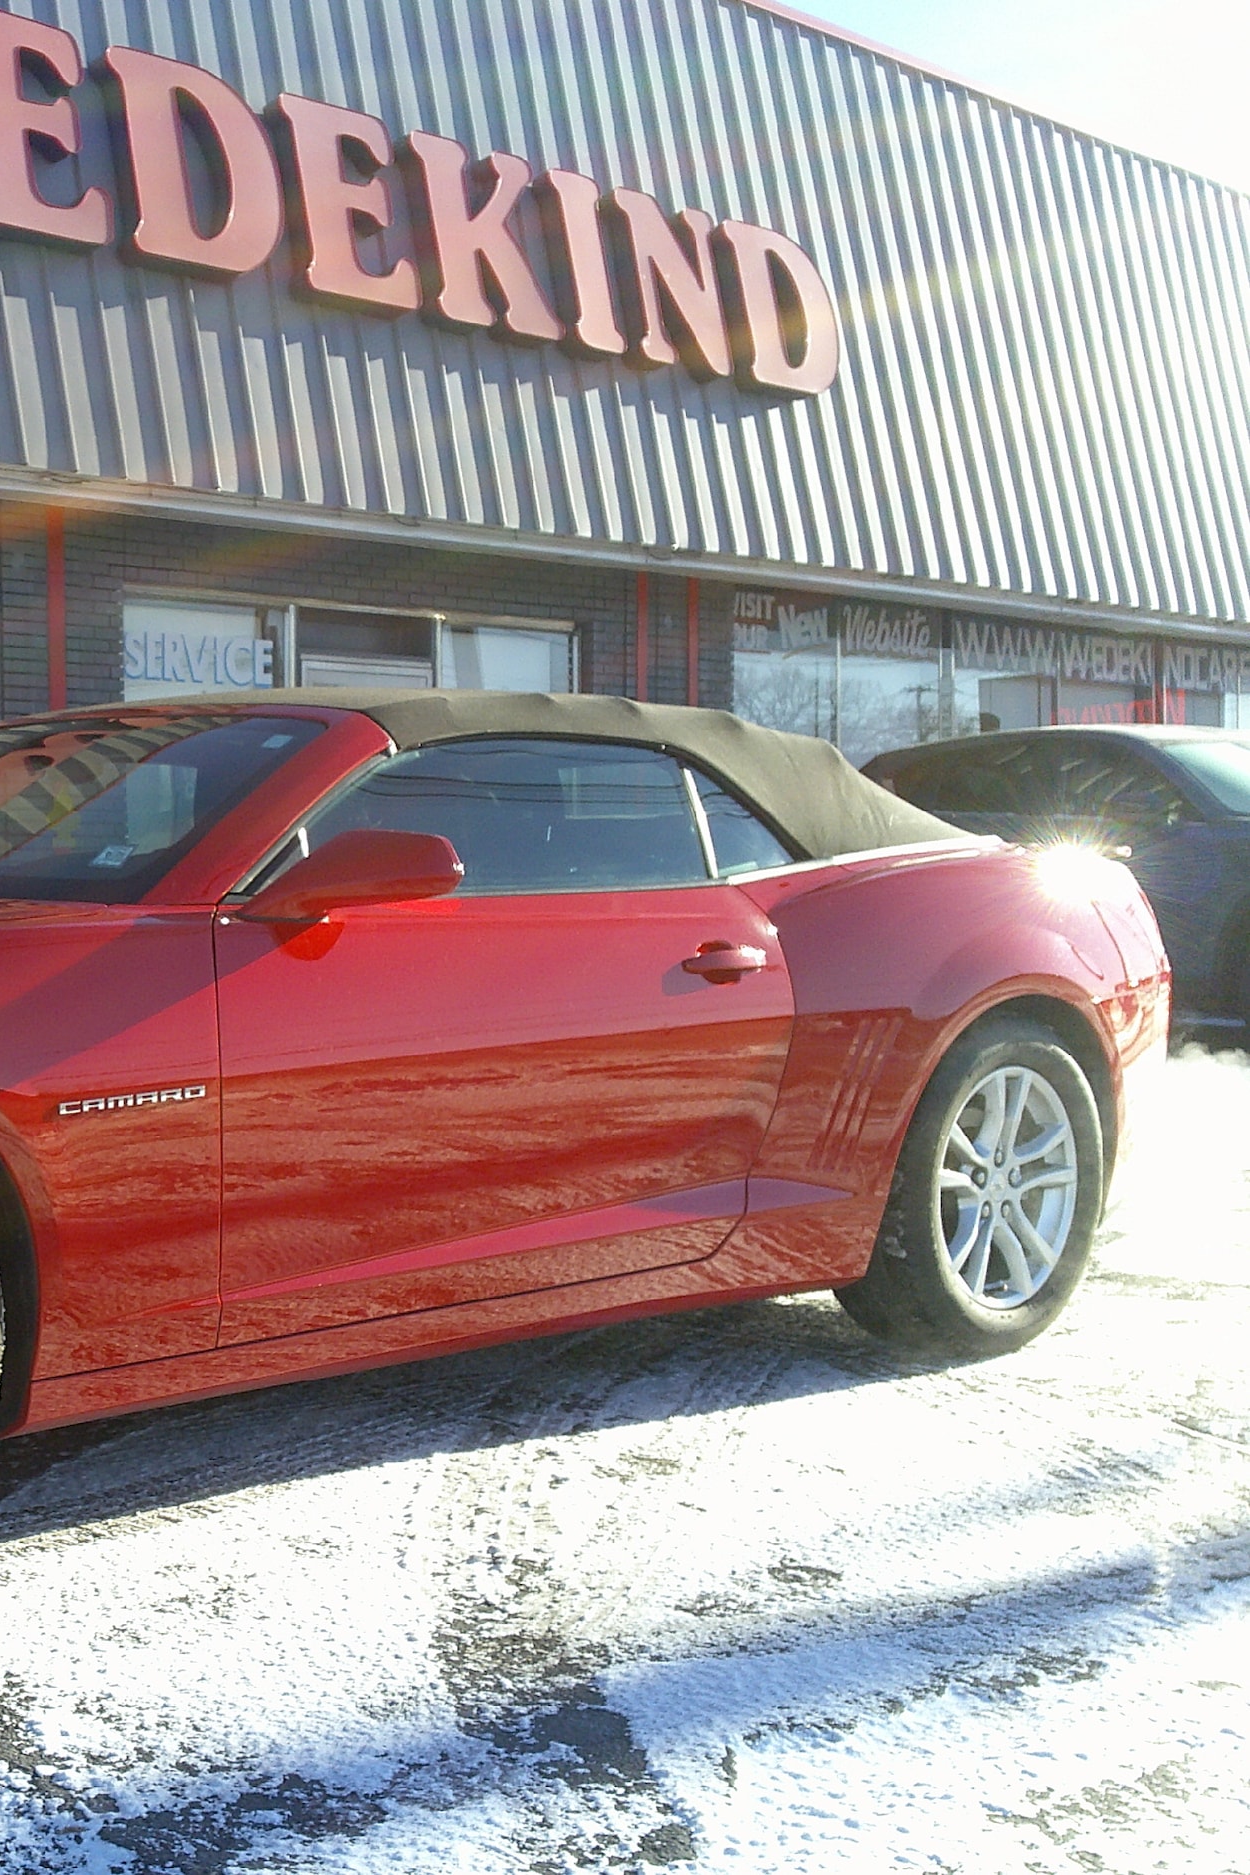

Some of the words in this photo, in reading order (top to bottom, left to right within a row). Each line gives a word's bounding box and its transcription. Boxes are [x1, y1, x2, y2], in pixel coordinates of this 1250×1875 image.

[843, 604, 931, 656] Website
[124, 631, 274, 688] SERVICE
[58, 1085, 207, 1116] CAMARO
